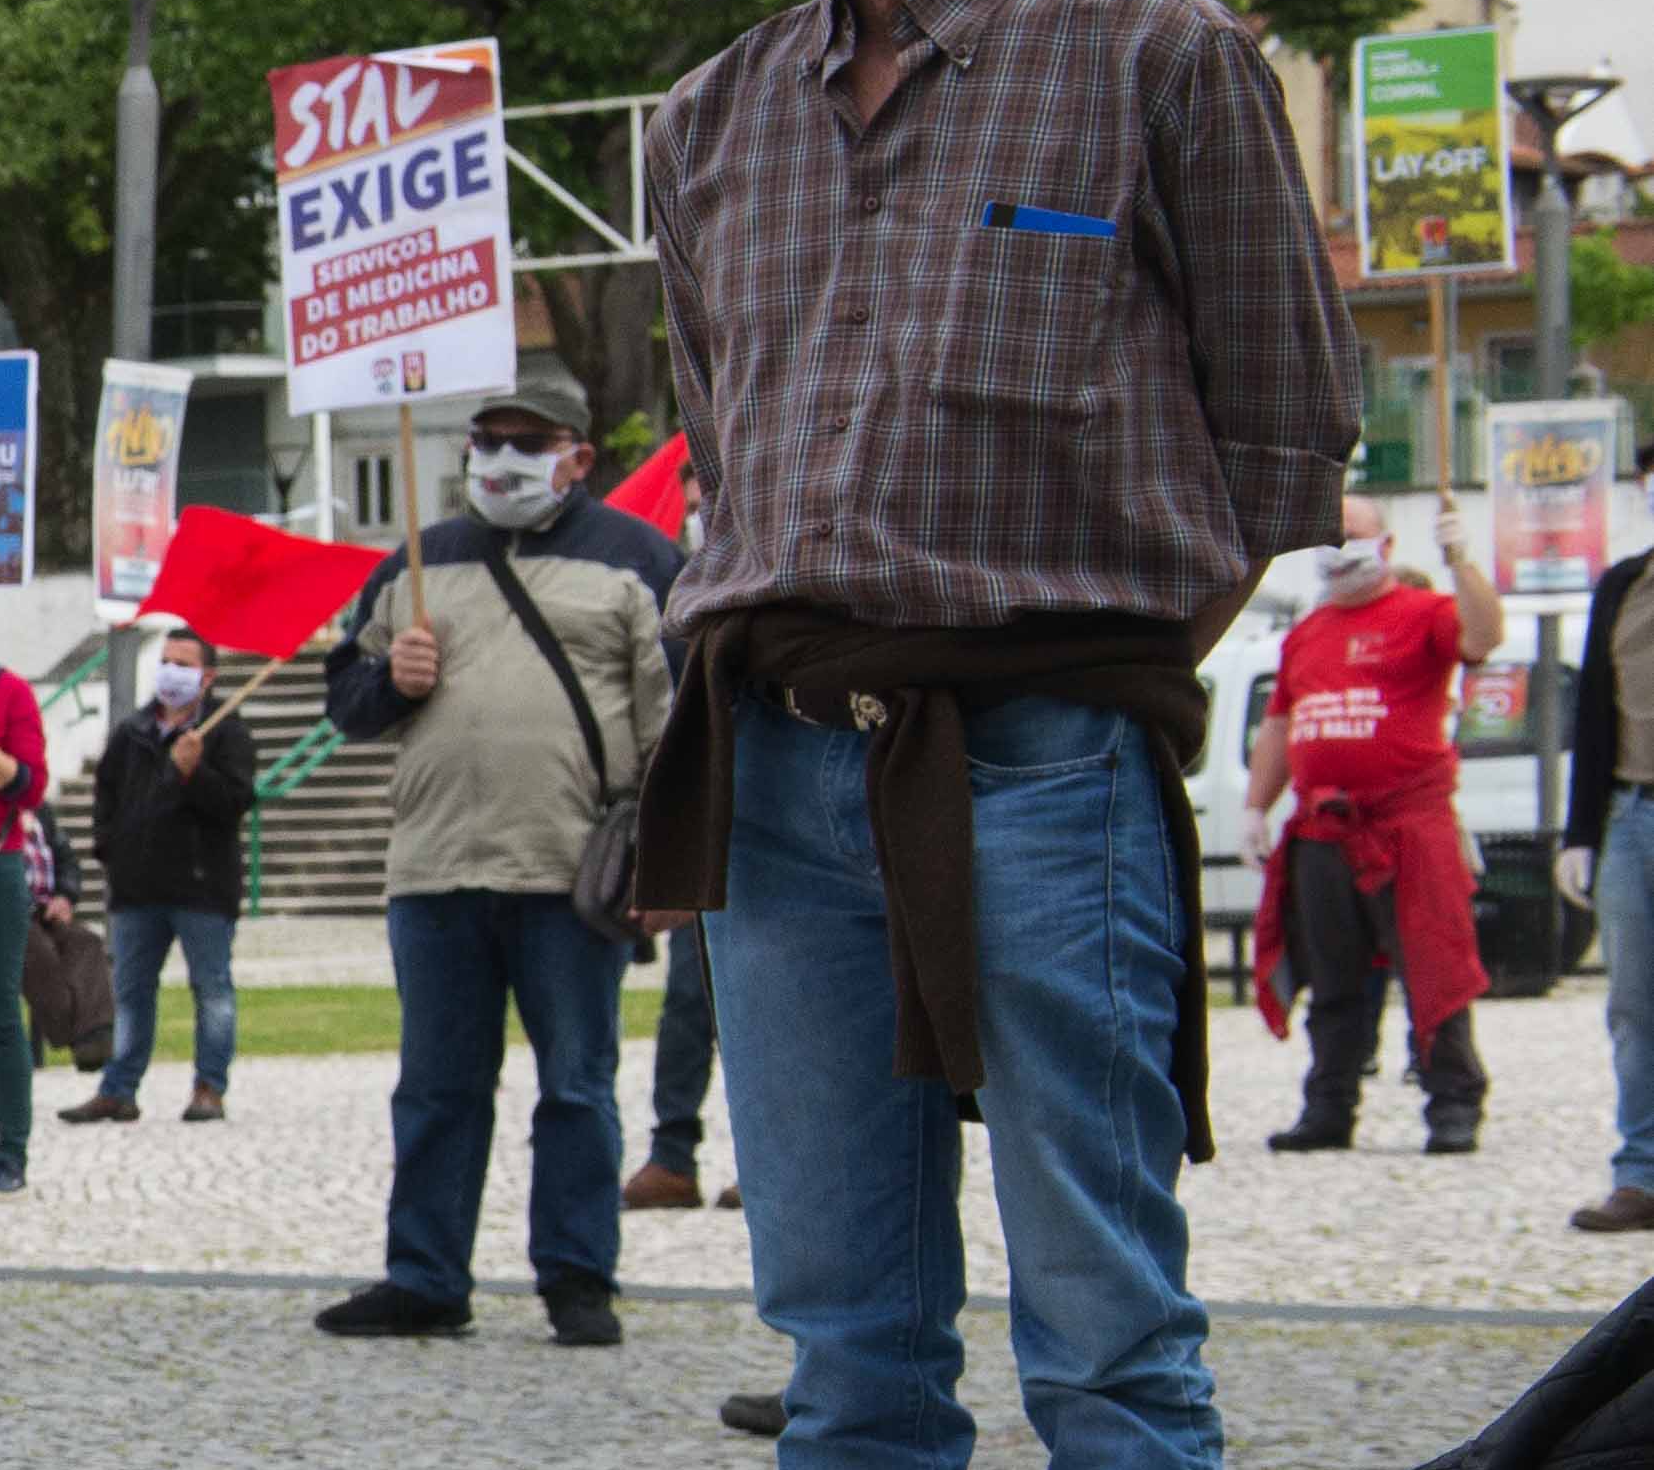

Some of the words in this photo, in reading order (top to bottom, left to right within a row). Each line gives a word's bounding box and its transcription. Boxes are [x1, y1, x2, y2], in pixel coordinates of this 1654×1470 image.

[283, 61, 441, 169] STAL
[290, 131, 491, 252] EXIGE
[1374, 144, 1487, 183] LAY-OFF
[305, 291, 342, 324] DE
[346, 249, 480, 311] MEDICINA
[318, 231, 434, 287] SERVIÇOS
[300, 324, 340, 359] DO
[343, 280, 490, 345] TRABALHO
